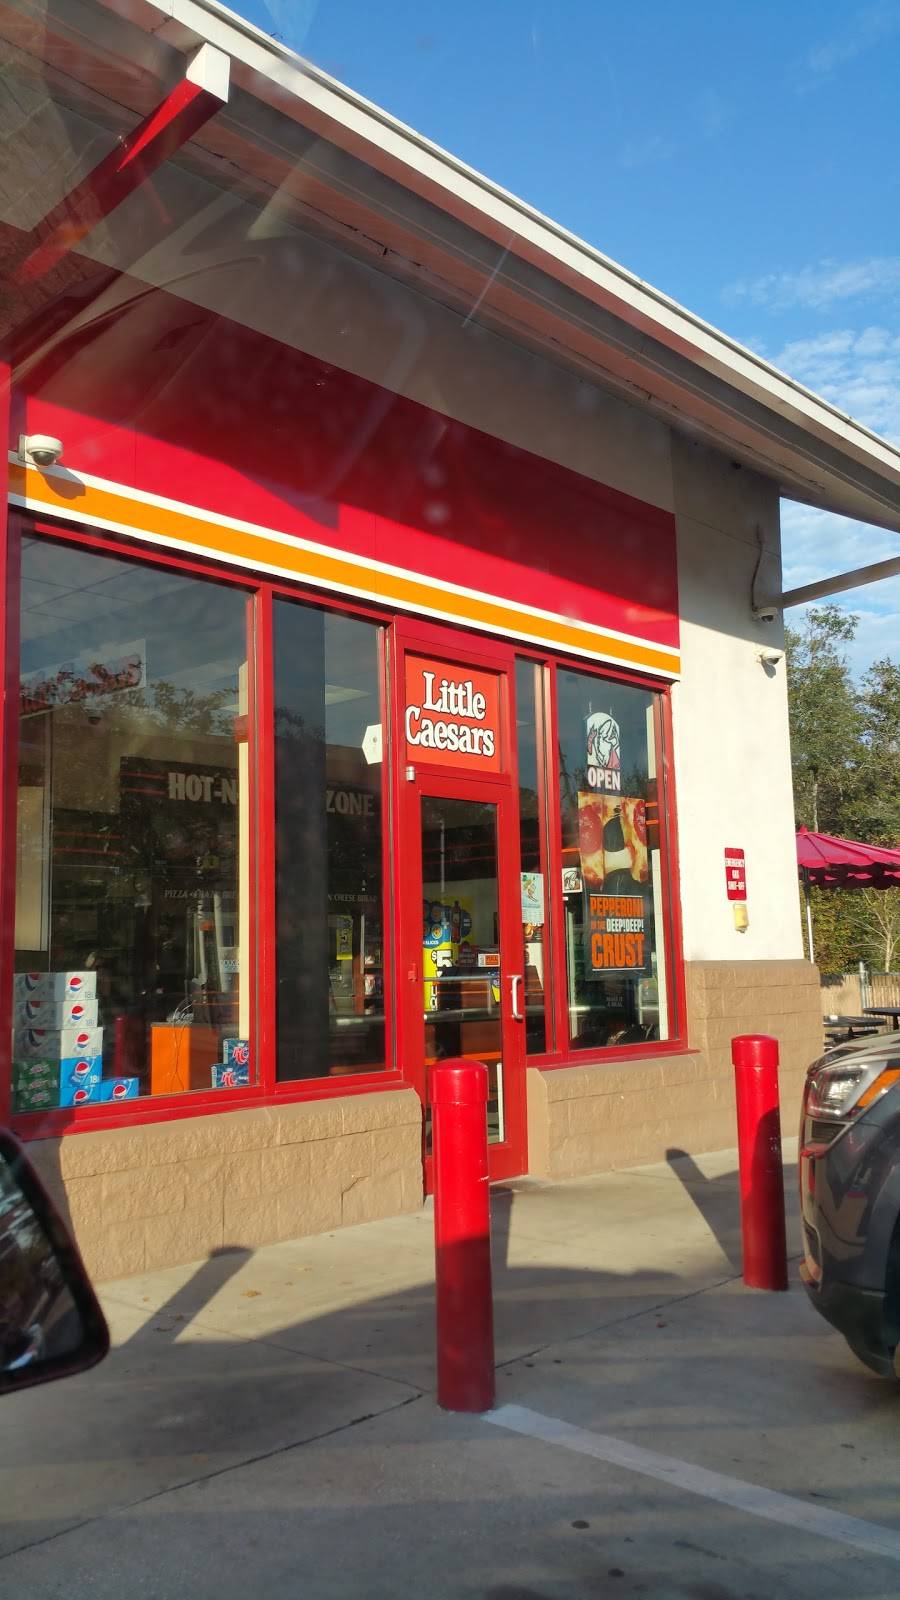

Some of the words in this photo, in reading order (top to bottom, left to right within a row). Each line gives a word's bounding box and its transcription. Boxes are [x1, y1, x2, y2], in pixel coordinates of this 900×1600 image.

[422, 670, 486, 720] Little
[405, 705, 495, 757] Caesars
[587, 766, 621, 791] OPEN
[326, 790, 375, 817] ZONE
[590, 896, 644, 917] PEPPERONI
[591, 933, 645, 968] CRUST
